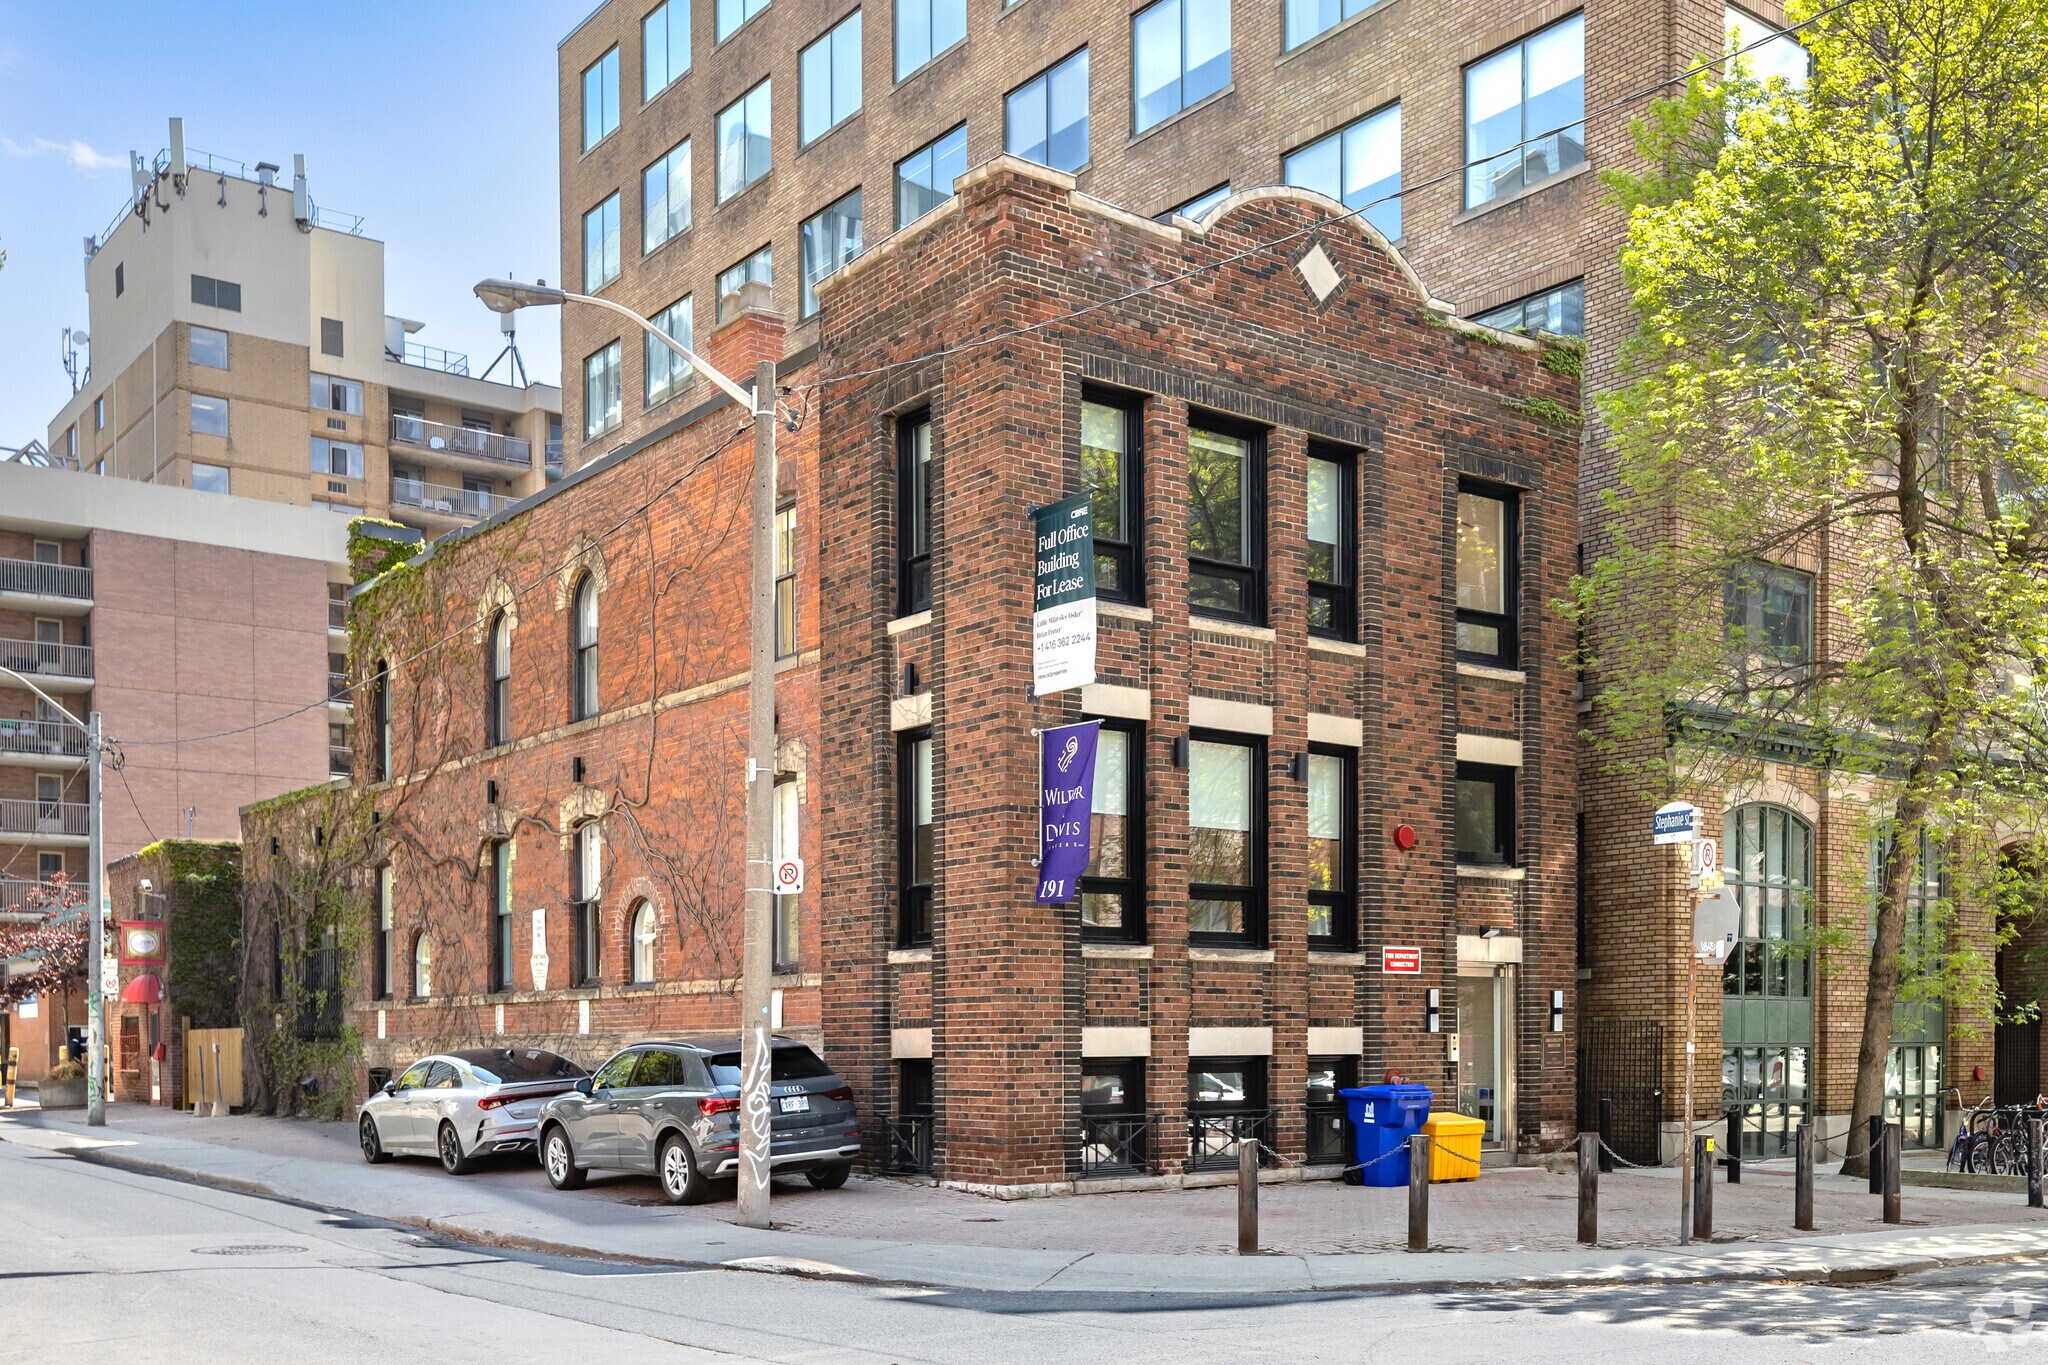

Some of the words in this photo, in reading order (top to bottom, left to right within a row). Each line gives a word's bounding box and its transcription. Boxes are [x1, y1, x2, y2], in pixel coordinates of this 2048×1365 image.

[1070, 506, 1088, 520] CBRE
[1038, 530, 1056, 553] Full
[1058, 524, 1089, 545] Office
[1038, 552, 1079, 577] Building
[1037, 583, 1053, 600] For
[1053, 576, 1083, 595] Lease
[1037, 631, 1048, 639] Brian
[1037, 643, 1044, 652] +1
[1044, 640, 1056, 650] 416
[1057, 636, 1070, 648] 362
[1071, 632, 1091, 645] 2244
[1655, 812, 1684, 832] Stephanie
[1040, 879, 1065, 898] 191
